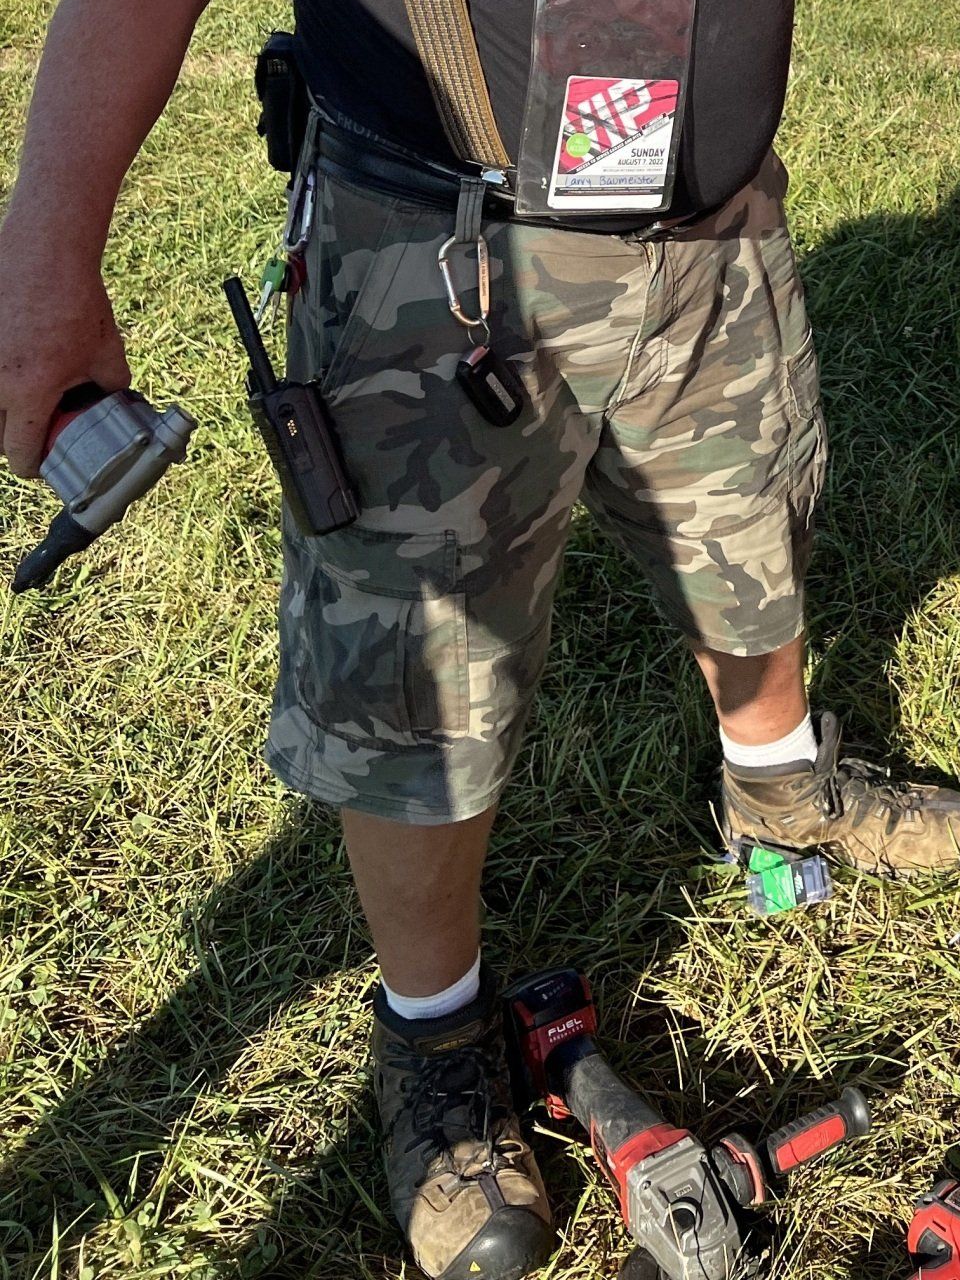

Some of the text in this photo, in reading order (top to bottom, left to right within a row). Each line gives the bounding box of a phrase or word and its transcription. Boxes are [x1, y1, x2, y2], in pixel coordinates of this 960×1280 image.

[630, 147, 666, 158] SUNDAY
[617, 158, 641, 166] AUGUST
[648, 158, 664, 166] 2022
[599, 175, 656, 186] Baumeister
[547, 1018, 582, 1037] FUEL
